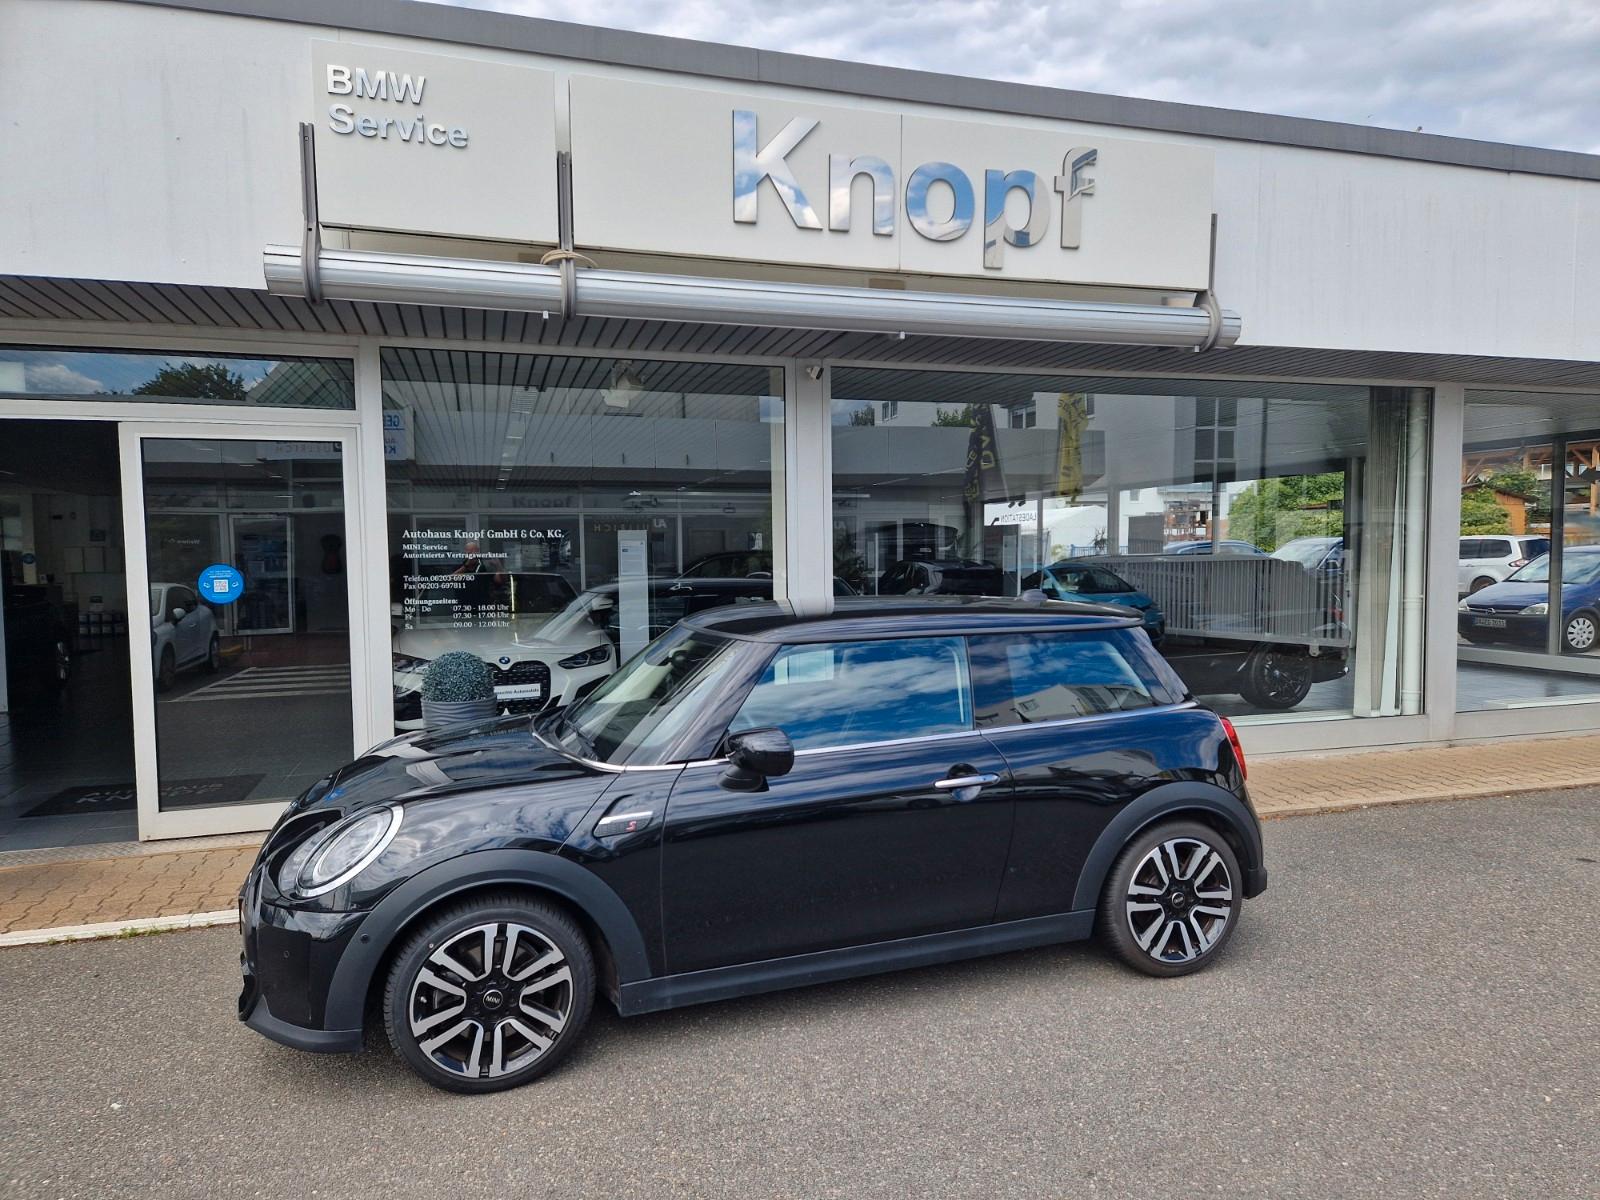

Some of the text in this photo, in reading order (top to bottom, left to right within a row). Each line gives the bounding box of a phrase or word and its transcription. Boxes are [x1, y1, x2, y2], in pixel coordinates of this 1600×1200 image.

[326, 63, 426, 106] BMW
[327, 102, 469, 149] Service
[732, 109, 1098, 269] Knopf
[402, 529, 565, 540] Autohaus Knopf GmbH & Co. KG.
[402, 543, 448, 551] MINI Service
[402, 551, 508, 560] Autorisierte Vertragswerkstatt
[403, 575, 429, 583] Telefon
[403, 582, 466, 590] Fax 06203-697811
[404, 613, 413, 621] Fr
[453, 621, 473, 629] 09.00
[496, 620, 509, 628] Uhr
[626, 819, 638, 832] S
